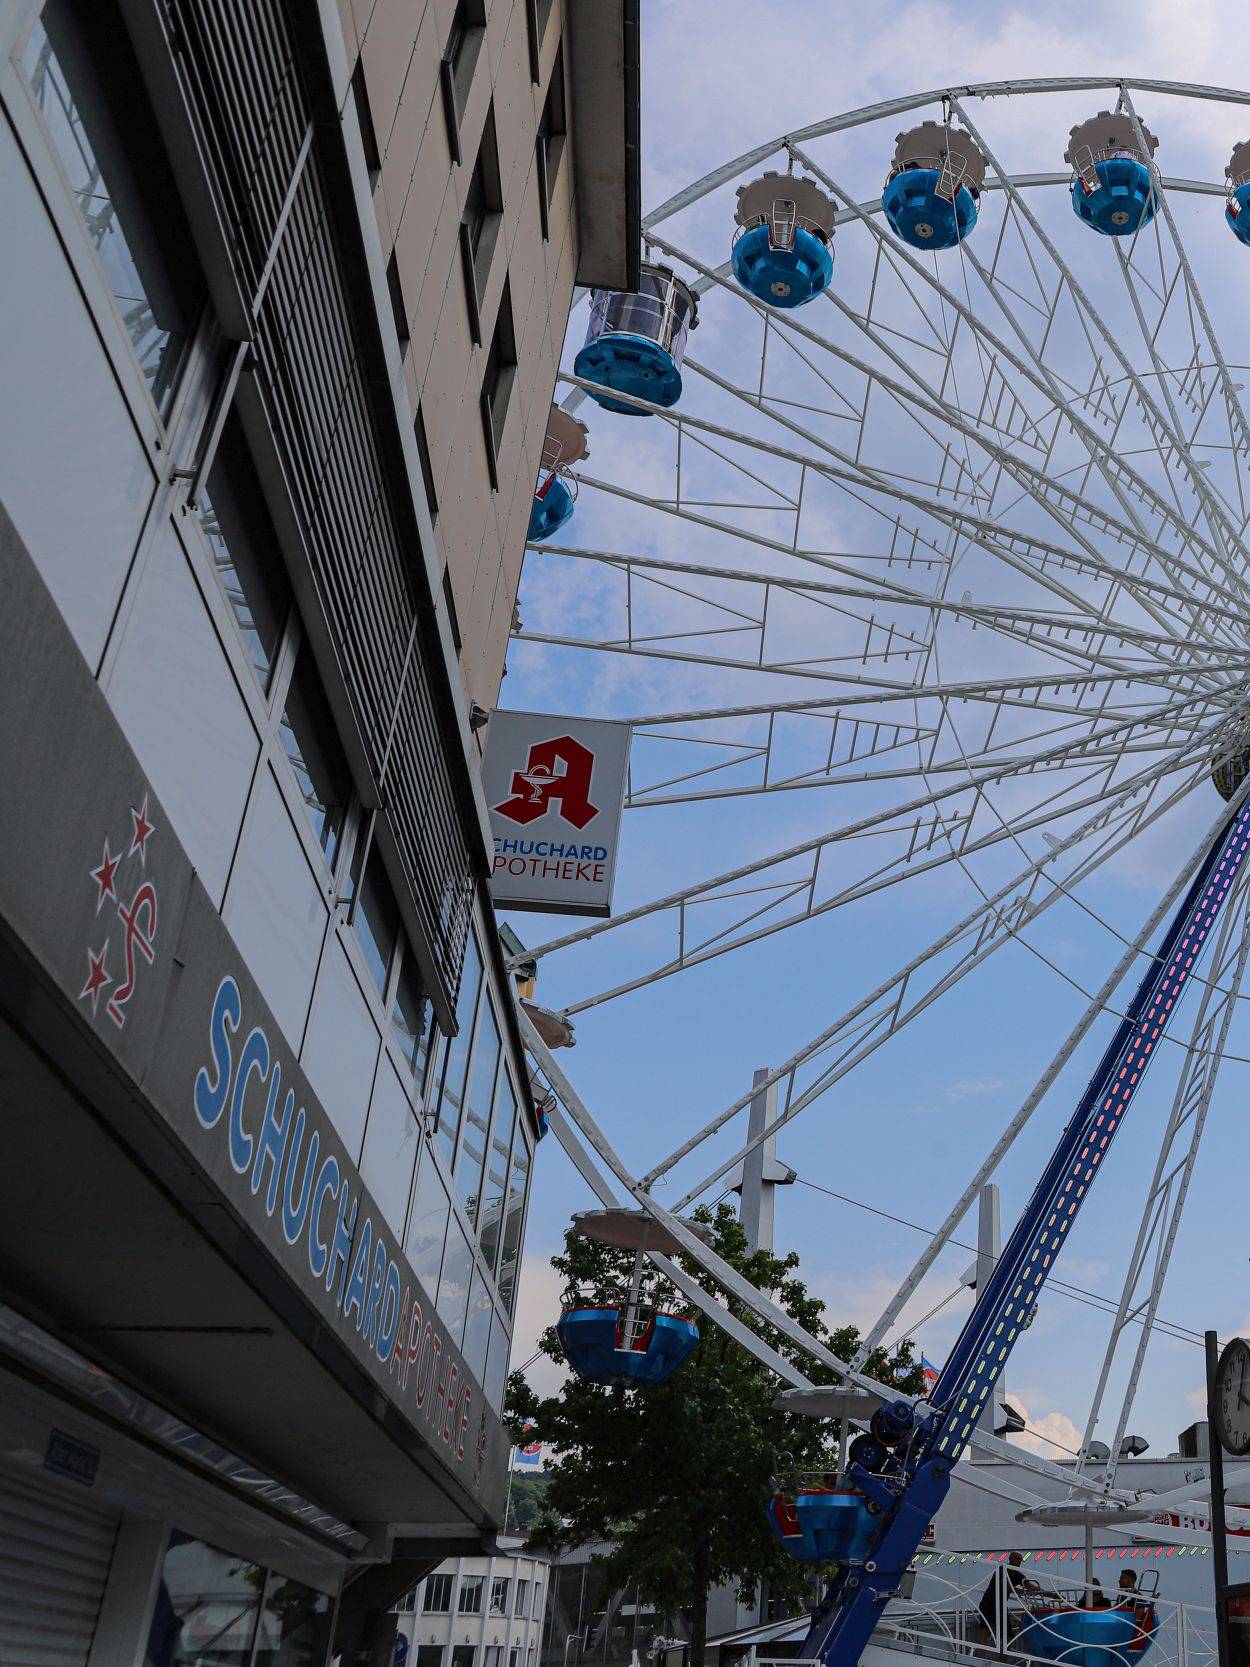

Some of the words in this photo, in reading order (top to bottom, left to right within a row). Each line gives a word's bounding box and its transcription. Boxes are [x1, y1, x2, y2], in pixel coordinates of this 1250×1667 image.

[492, 856, 605, 883] POTHEKE
[194, 975, 400, 1363] SCHUCHARD
[389, 1285, 472, 1463] APOTHEKE
[1222, 1399, 1228, 1414] 9
[1226, 1419, 1232, 1434] 8
